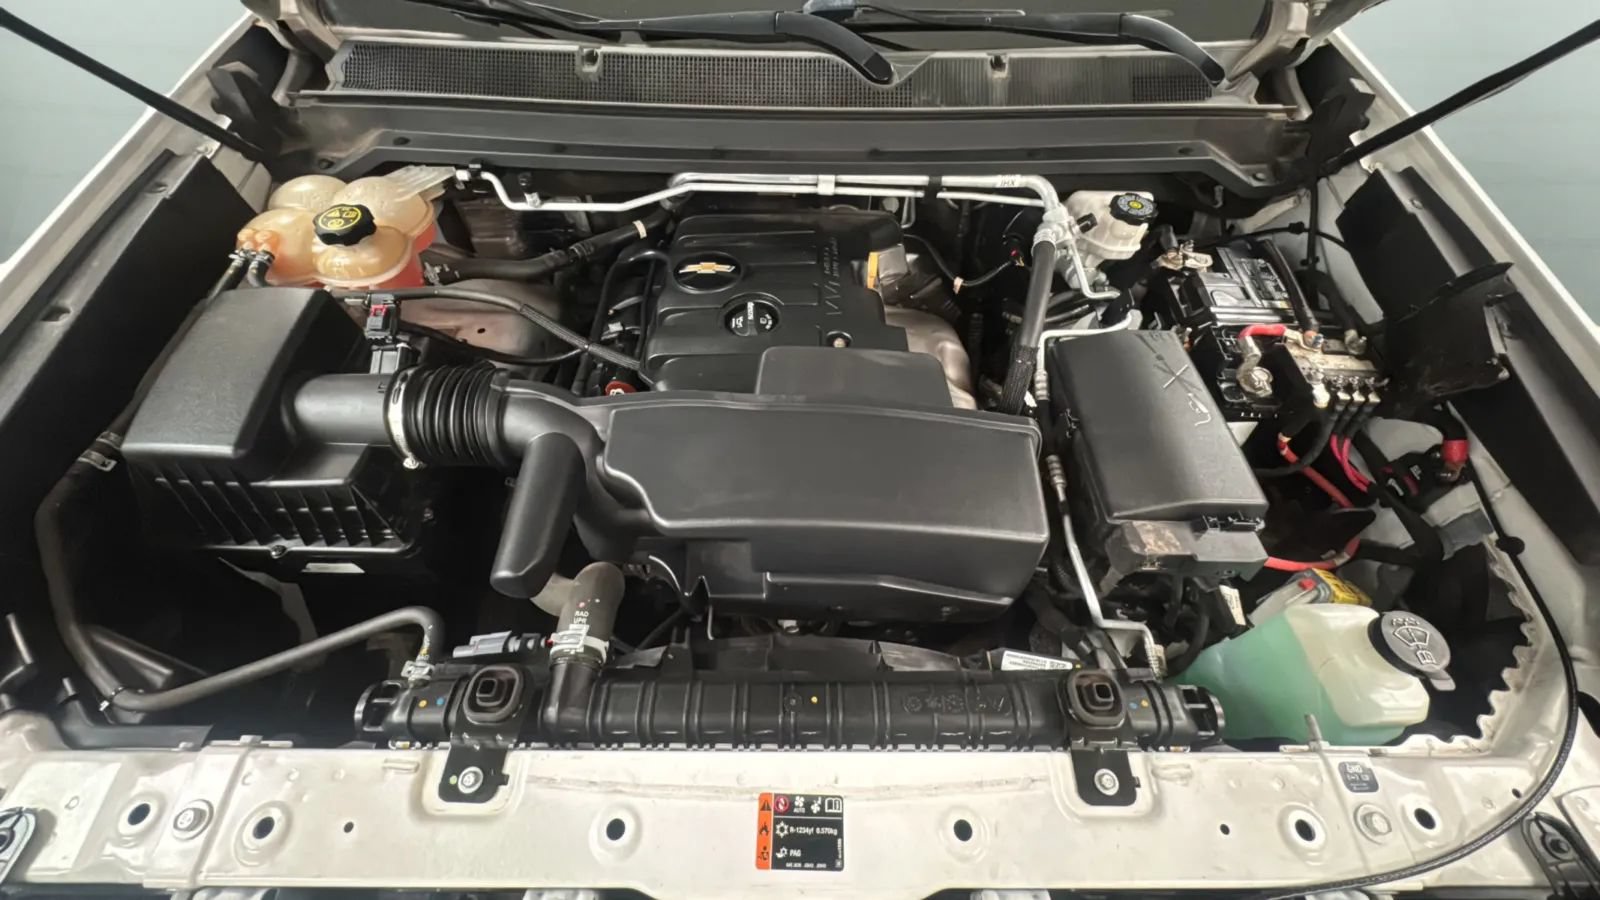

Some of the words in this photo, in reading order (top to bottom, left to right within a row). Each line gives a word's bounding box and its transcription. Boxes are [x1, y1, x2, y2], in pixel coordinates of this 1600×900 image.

[574, 610, 590, 618] RAD
[789, 826, 814, 836] R-1234yf
[789, 849, 802, 857] PAG
